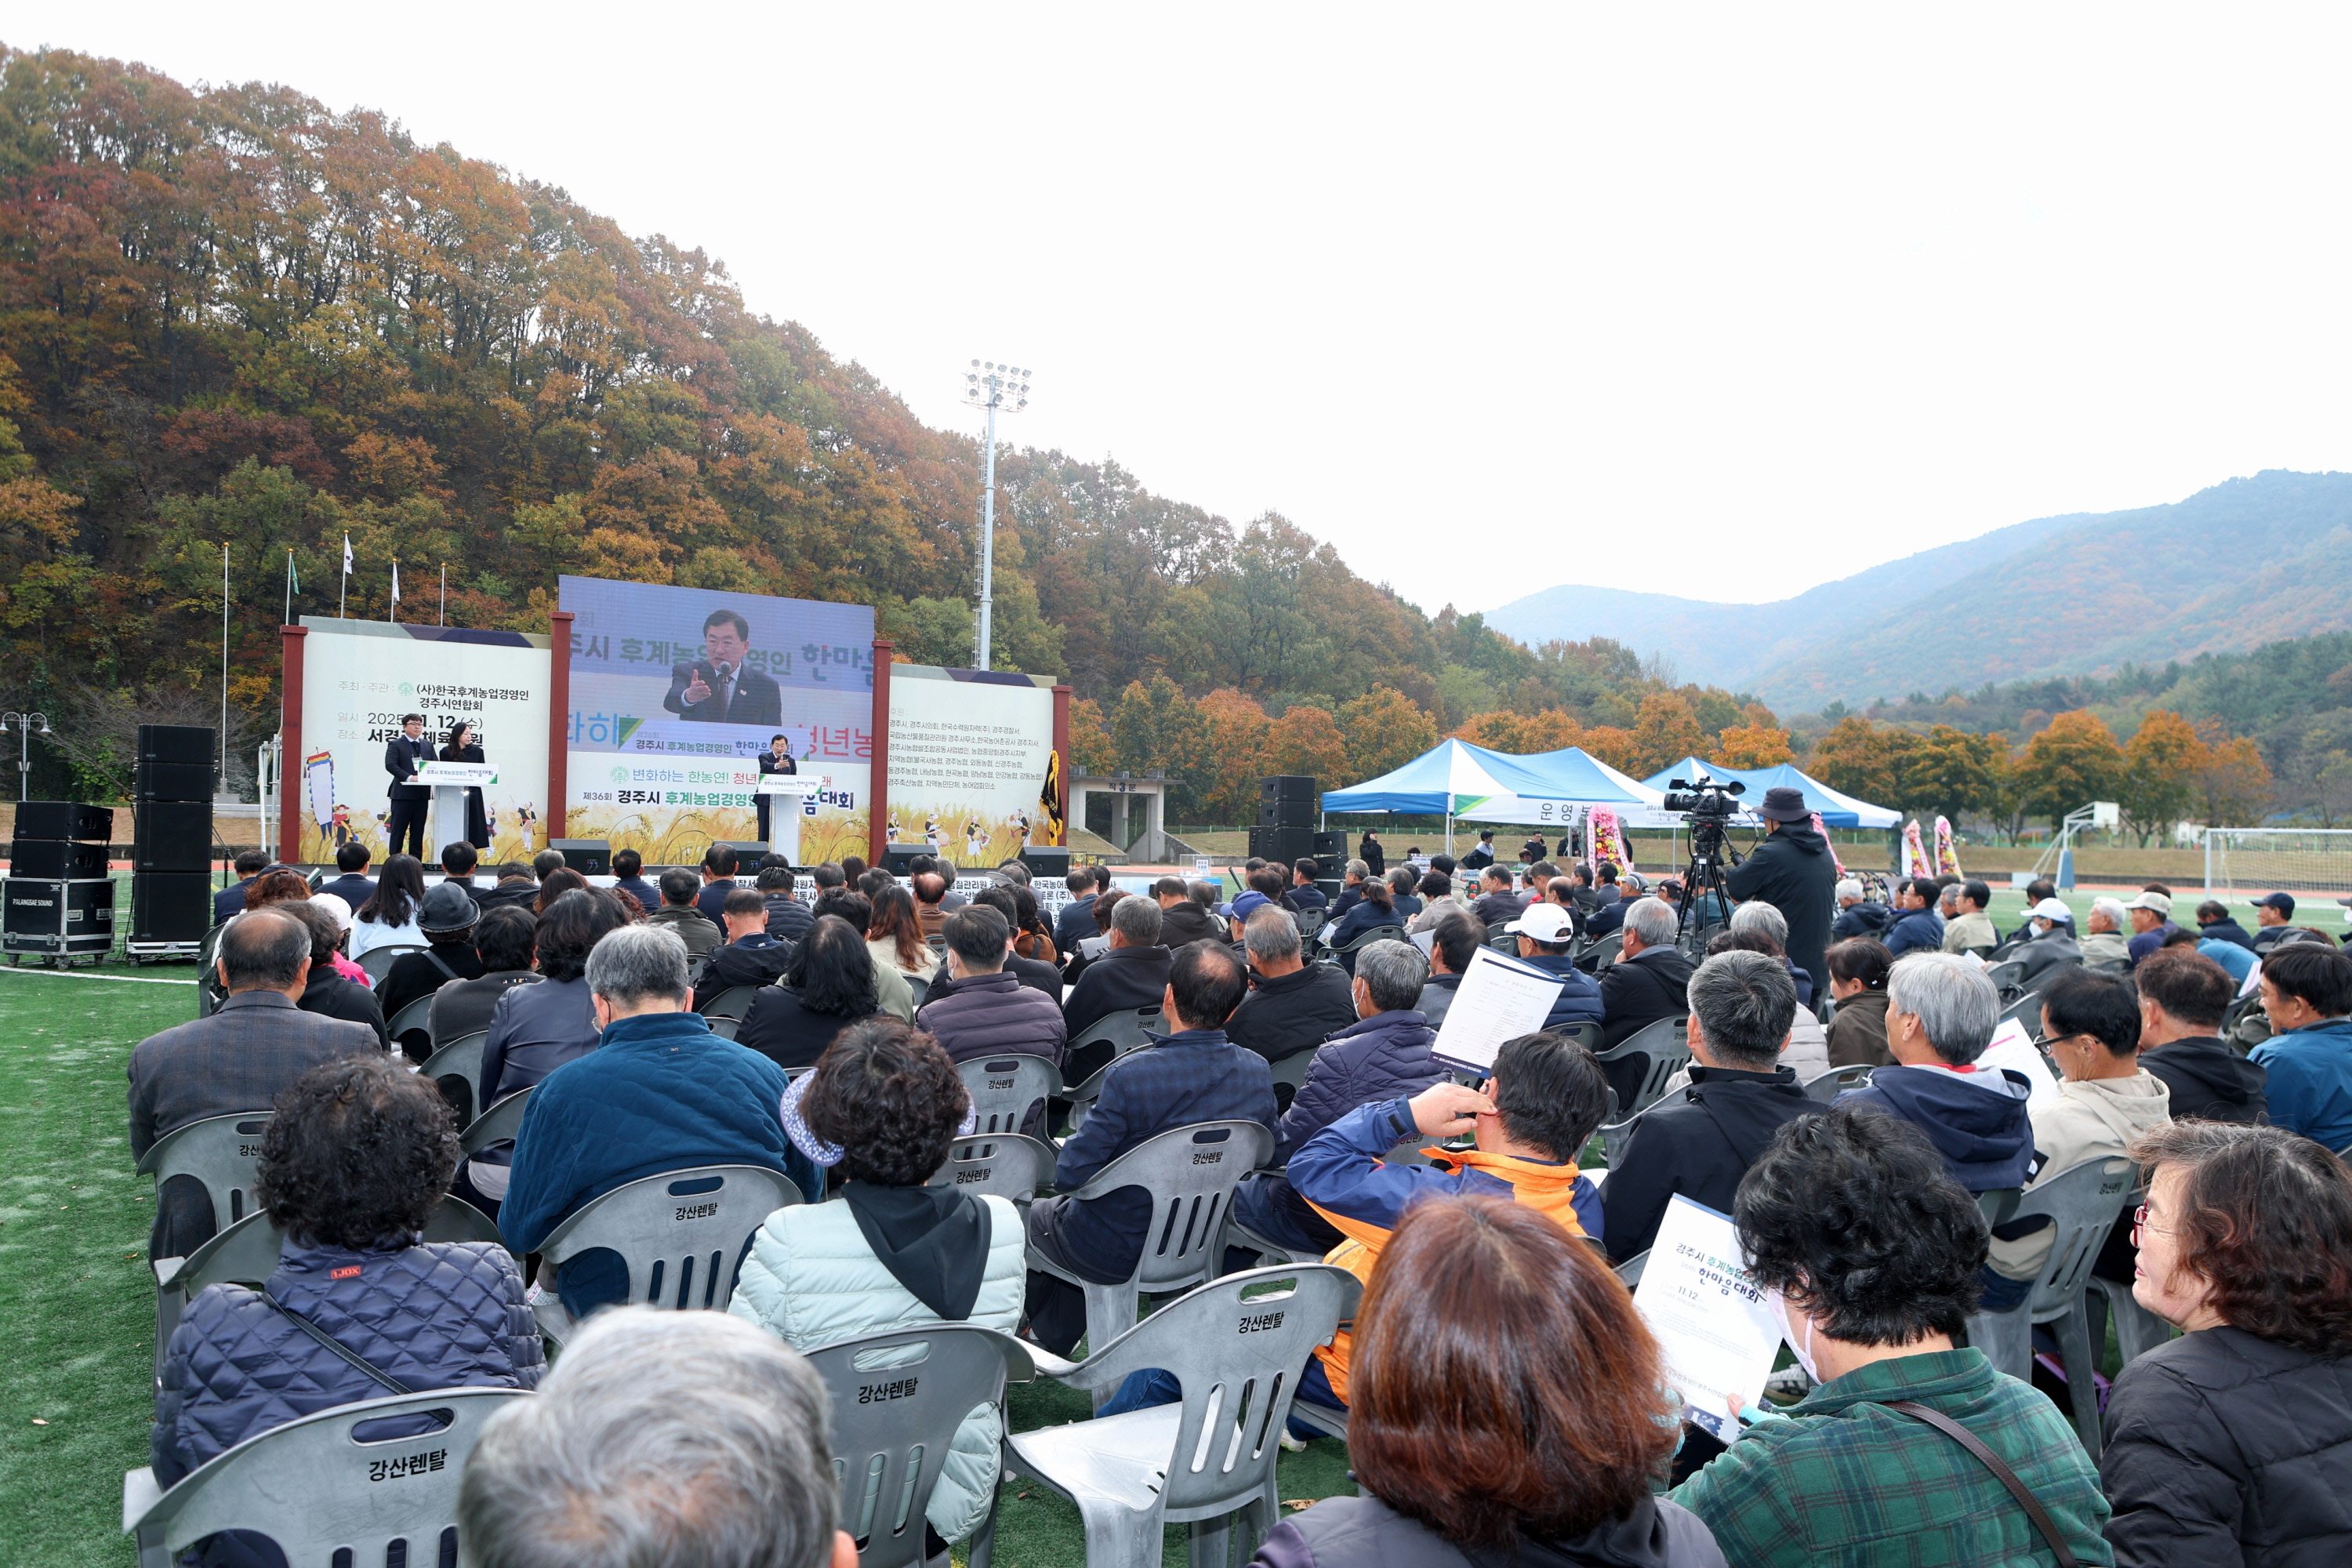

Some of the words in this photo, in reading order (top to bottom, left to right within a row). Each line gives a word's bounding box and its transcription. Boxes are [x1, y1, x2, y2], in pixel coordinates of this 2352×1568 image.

[338, 681, 359, 691] 주최
[368, 682, 389, 693] 주관
[416, 684, 529, 701] (사)한국후계농업경영인
[419, 698, 483, 711] 경주시연합회
[890, 707, 905, 717] 후원
[338, 712, 359, 722] 일시
[437, 714, 456, 729] 12
[889, 719, 909, 728] 경주시,
[909, 720, 939, 731] 경주시의회,
[337, 729, 359, 739] 장소
[889, 731, 947, 742] 국립농산물품질관리원
[636, 739, 664, 750] 경주시
[667, 741, 731, 754] 후계농업경영인
[633, 768, 684, 782] 변화하는
[688, 771, 729, 784] 한농연!
[583, 792, 612, 800] 제36회
[618, 789, 660, 804] 경주시
[988, 1077, 1015, 1090] 강산렌탈
[239, 1145, 260, 1156] 강산
[1192, 1150, 1224, 1165] 강산렌탈
[956, 1167, 992, 1185] 강산렌탈
[675, 1202, 719, 1221] 강산렌탈
[1676, 1242, 1705, 1263] 경주시
[1699, 1267, 1759, 1304] 한마음대회
[1238, 1310, 1285, 1335] 강산렌탈
[858, 1377, 920, 1404] 강산렌탈
[368, 1448, 448, 1482] 강산렌탈
